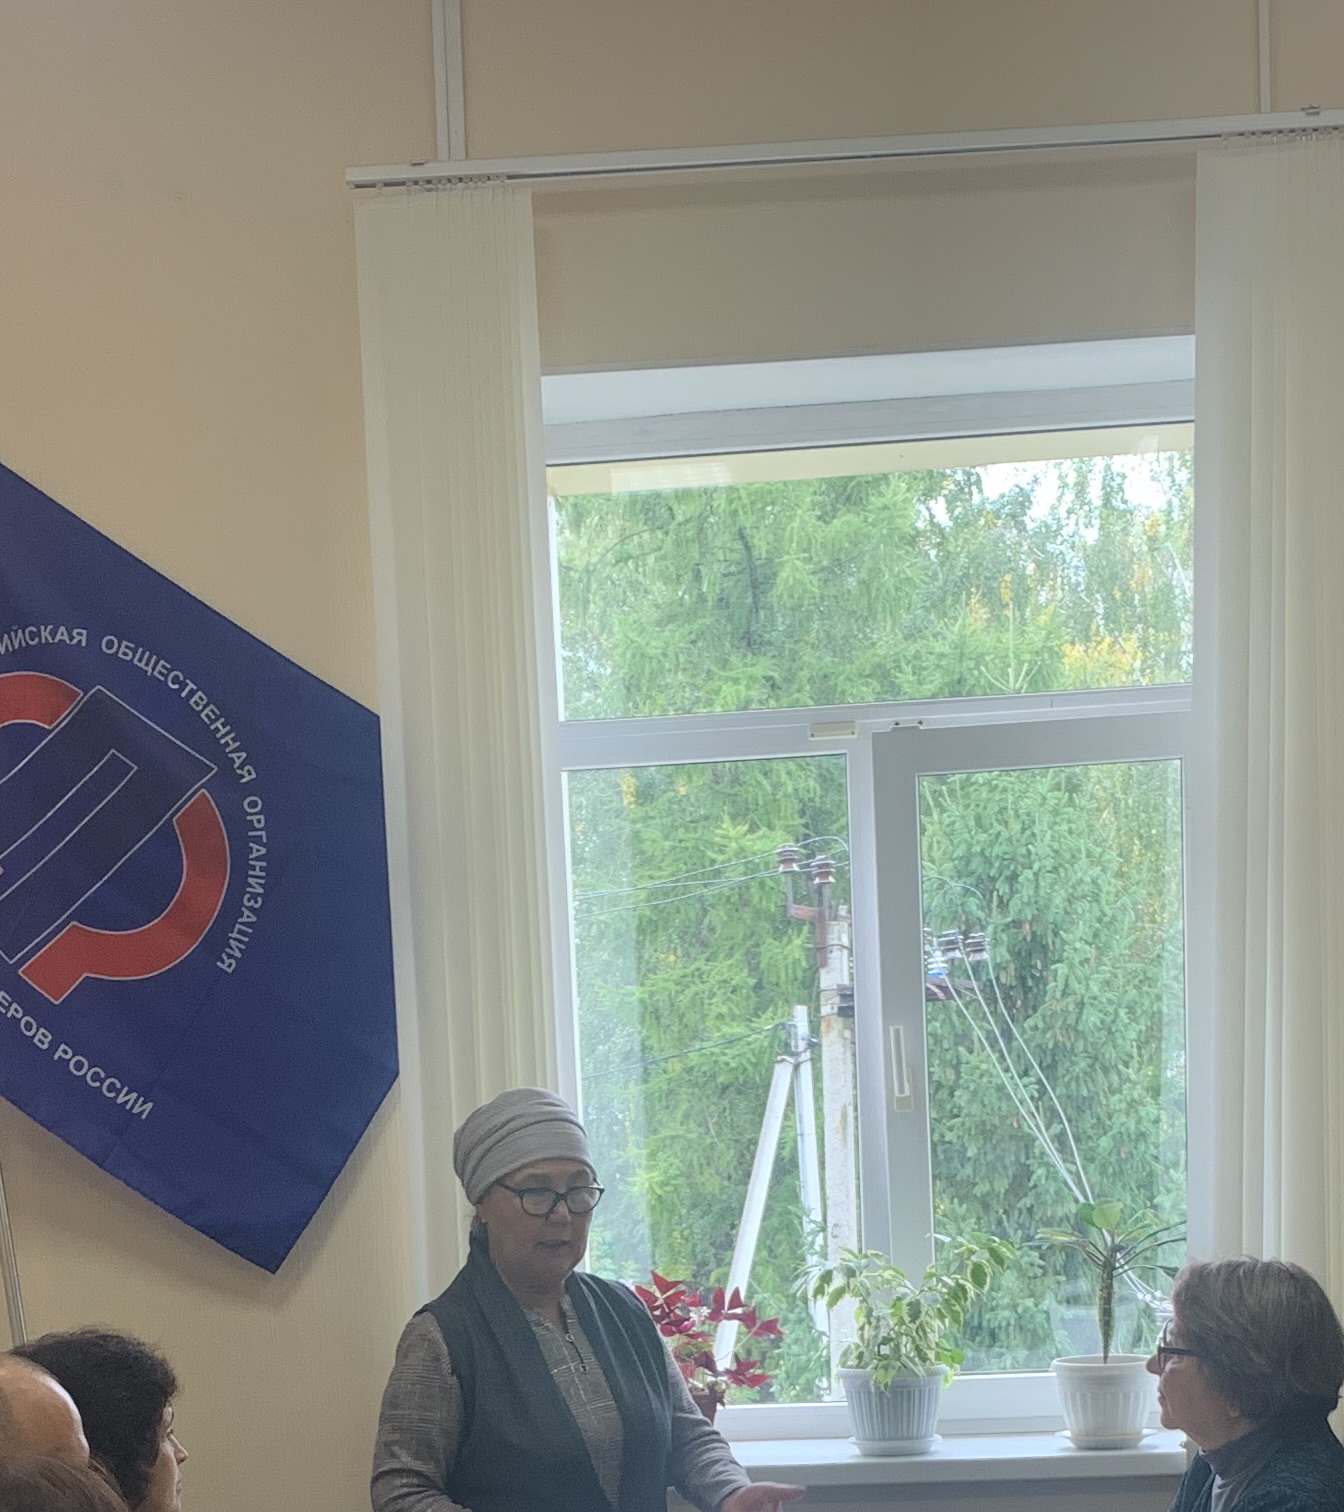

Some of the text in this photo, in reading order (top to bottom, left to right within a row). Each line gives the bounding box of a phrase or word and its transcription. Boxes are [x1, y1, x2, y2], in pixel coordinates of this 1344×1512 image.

[101, 635, 257, 784] ОБЩЕСТВЕННАЯ
[216, 795, 268, 974] ОРГАНИЗАЦИЯ
[54, 1043, 155, 1121] РОССИИ
